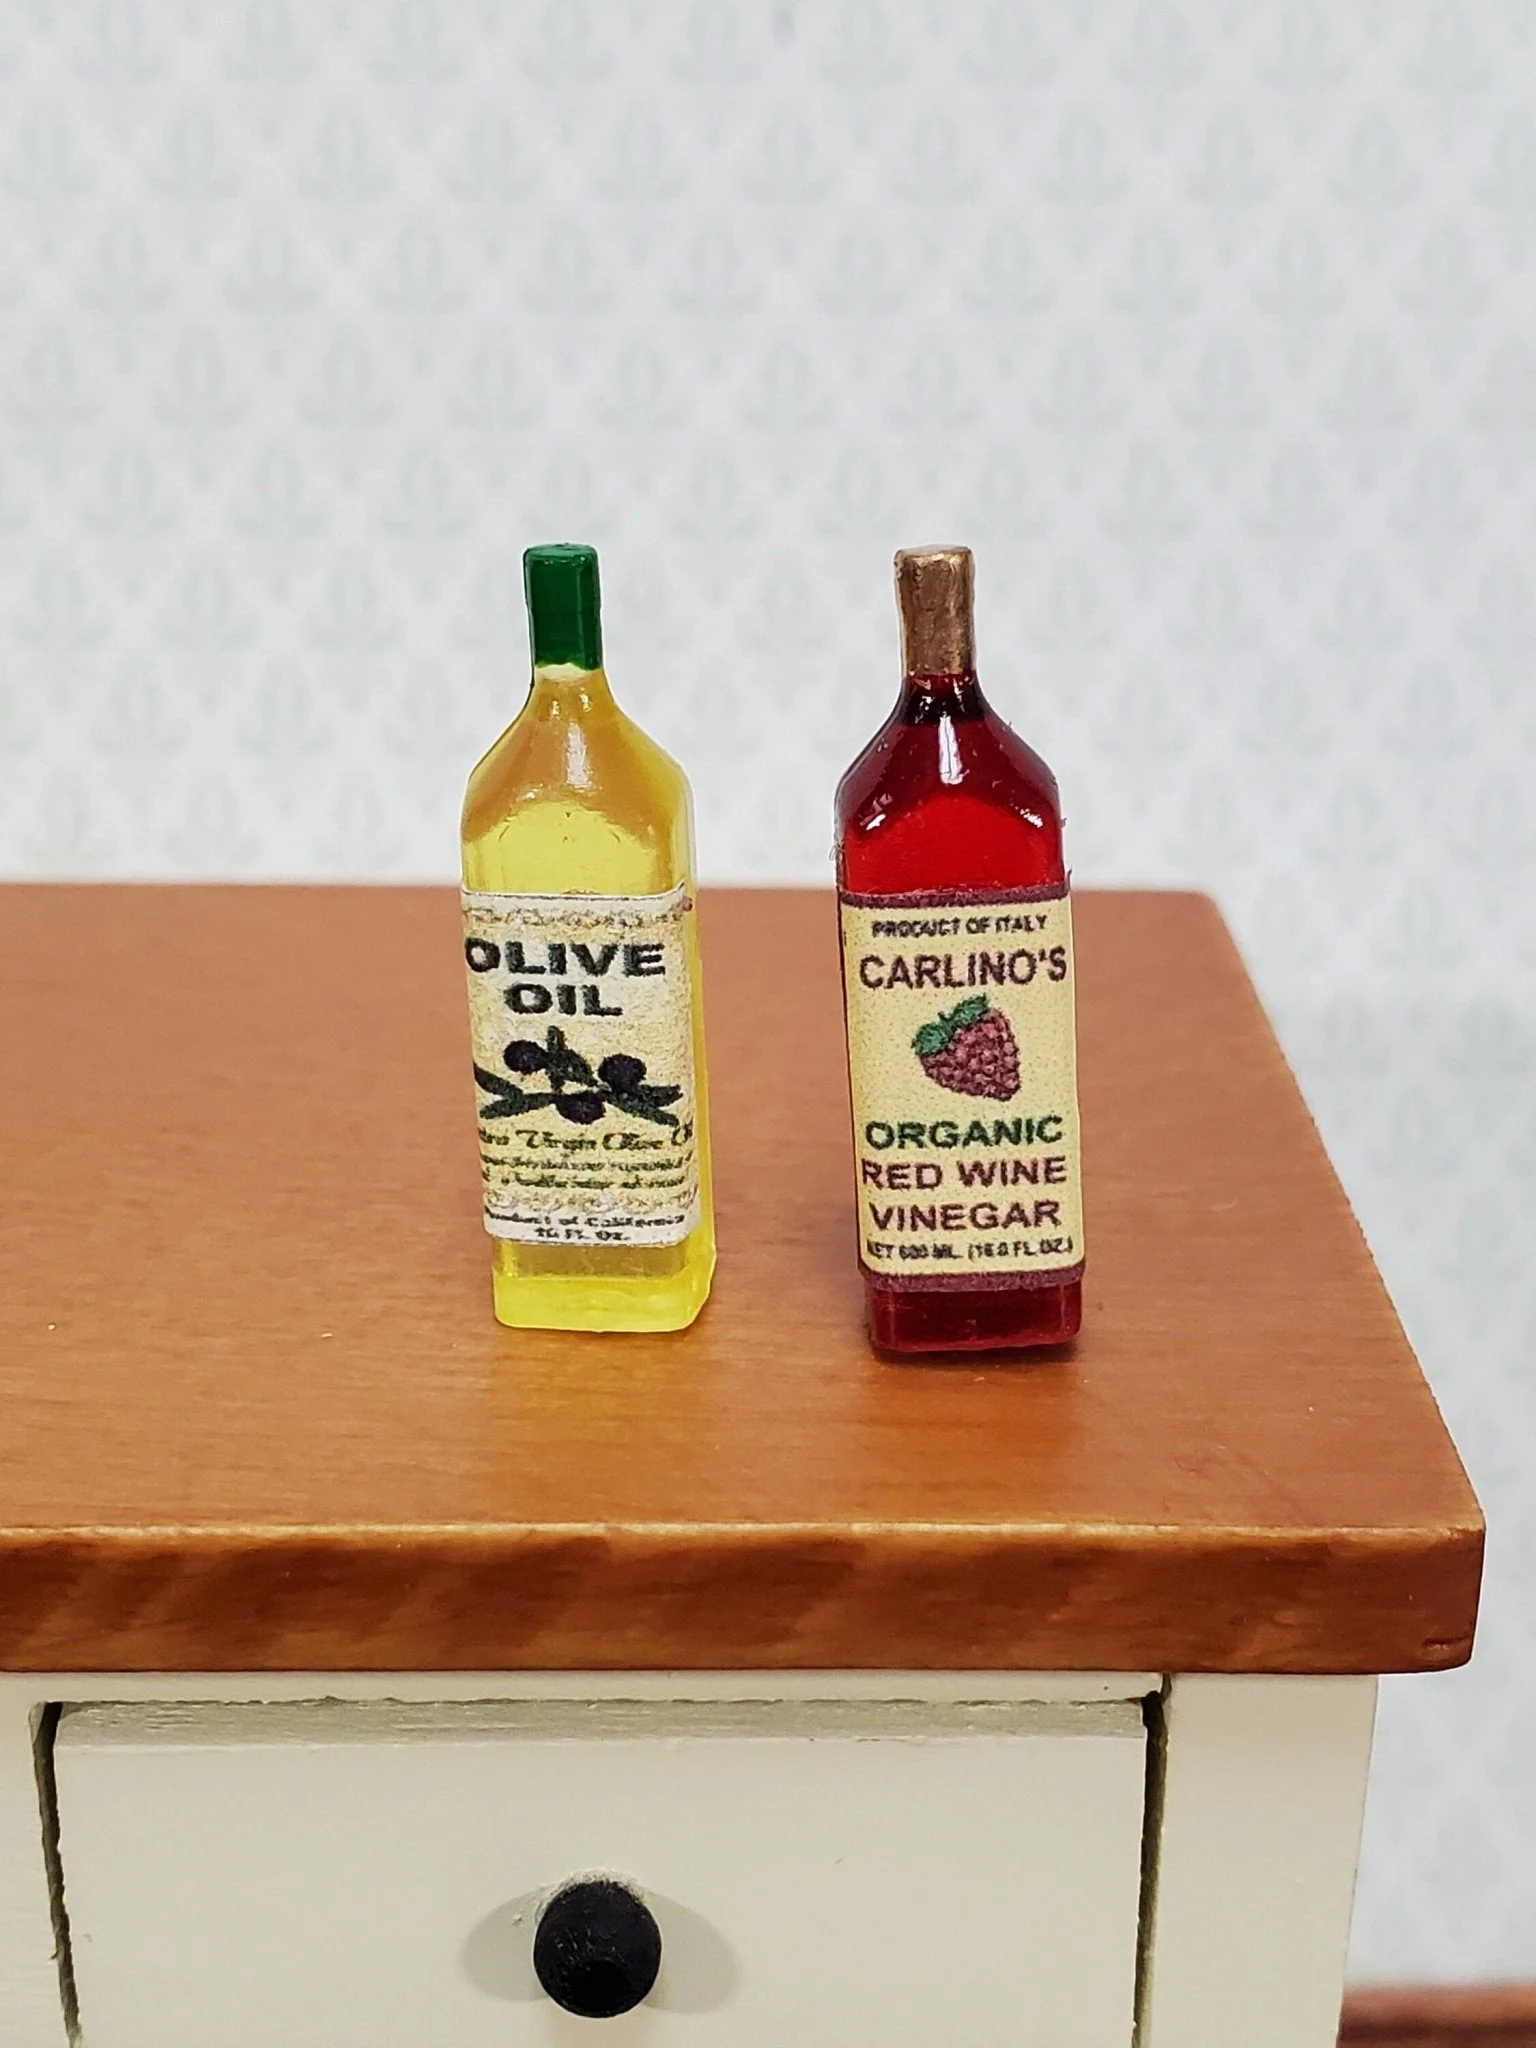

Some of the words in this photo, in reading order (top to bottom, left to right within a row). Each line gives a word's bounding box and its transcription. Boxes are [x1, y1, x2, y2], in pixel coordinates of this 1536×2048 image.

[871, 917, 960, 938] PRODUCT
[965, 916, 990, 935] OF
[995, 914, 1047, 934] ITALY
[465, 936, 665, 977] OLIVE
[860, 946, 1067, 989] CARLINO'S
[504, 983, 623, 1016] OIL
[865, 1115, 1063, 1150] ORGANIC
[861, 1158, 943, 1190] RED
[957, 1155, 1067, 1187] WINE
[869, 1199, 1062, 1231] VINEGAR
